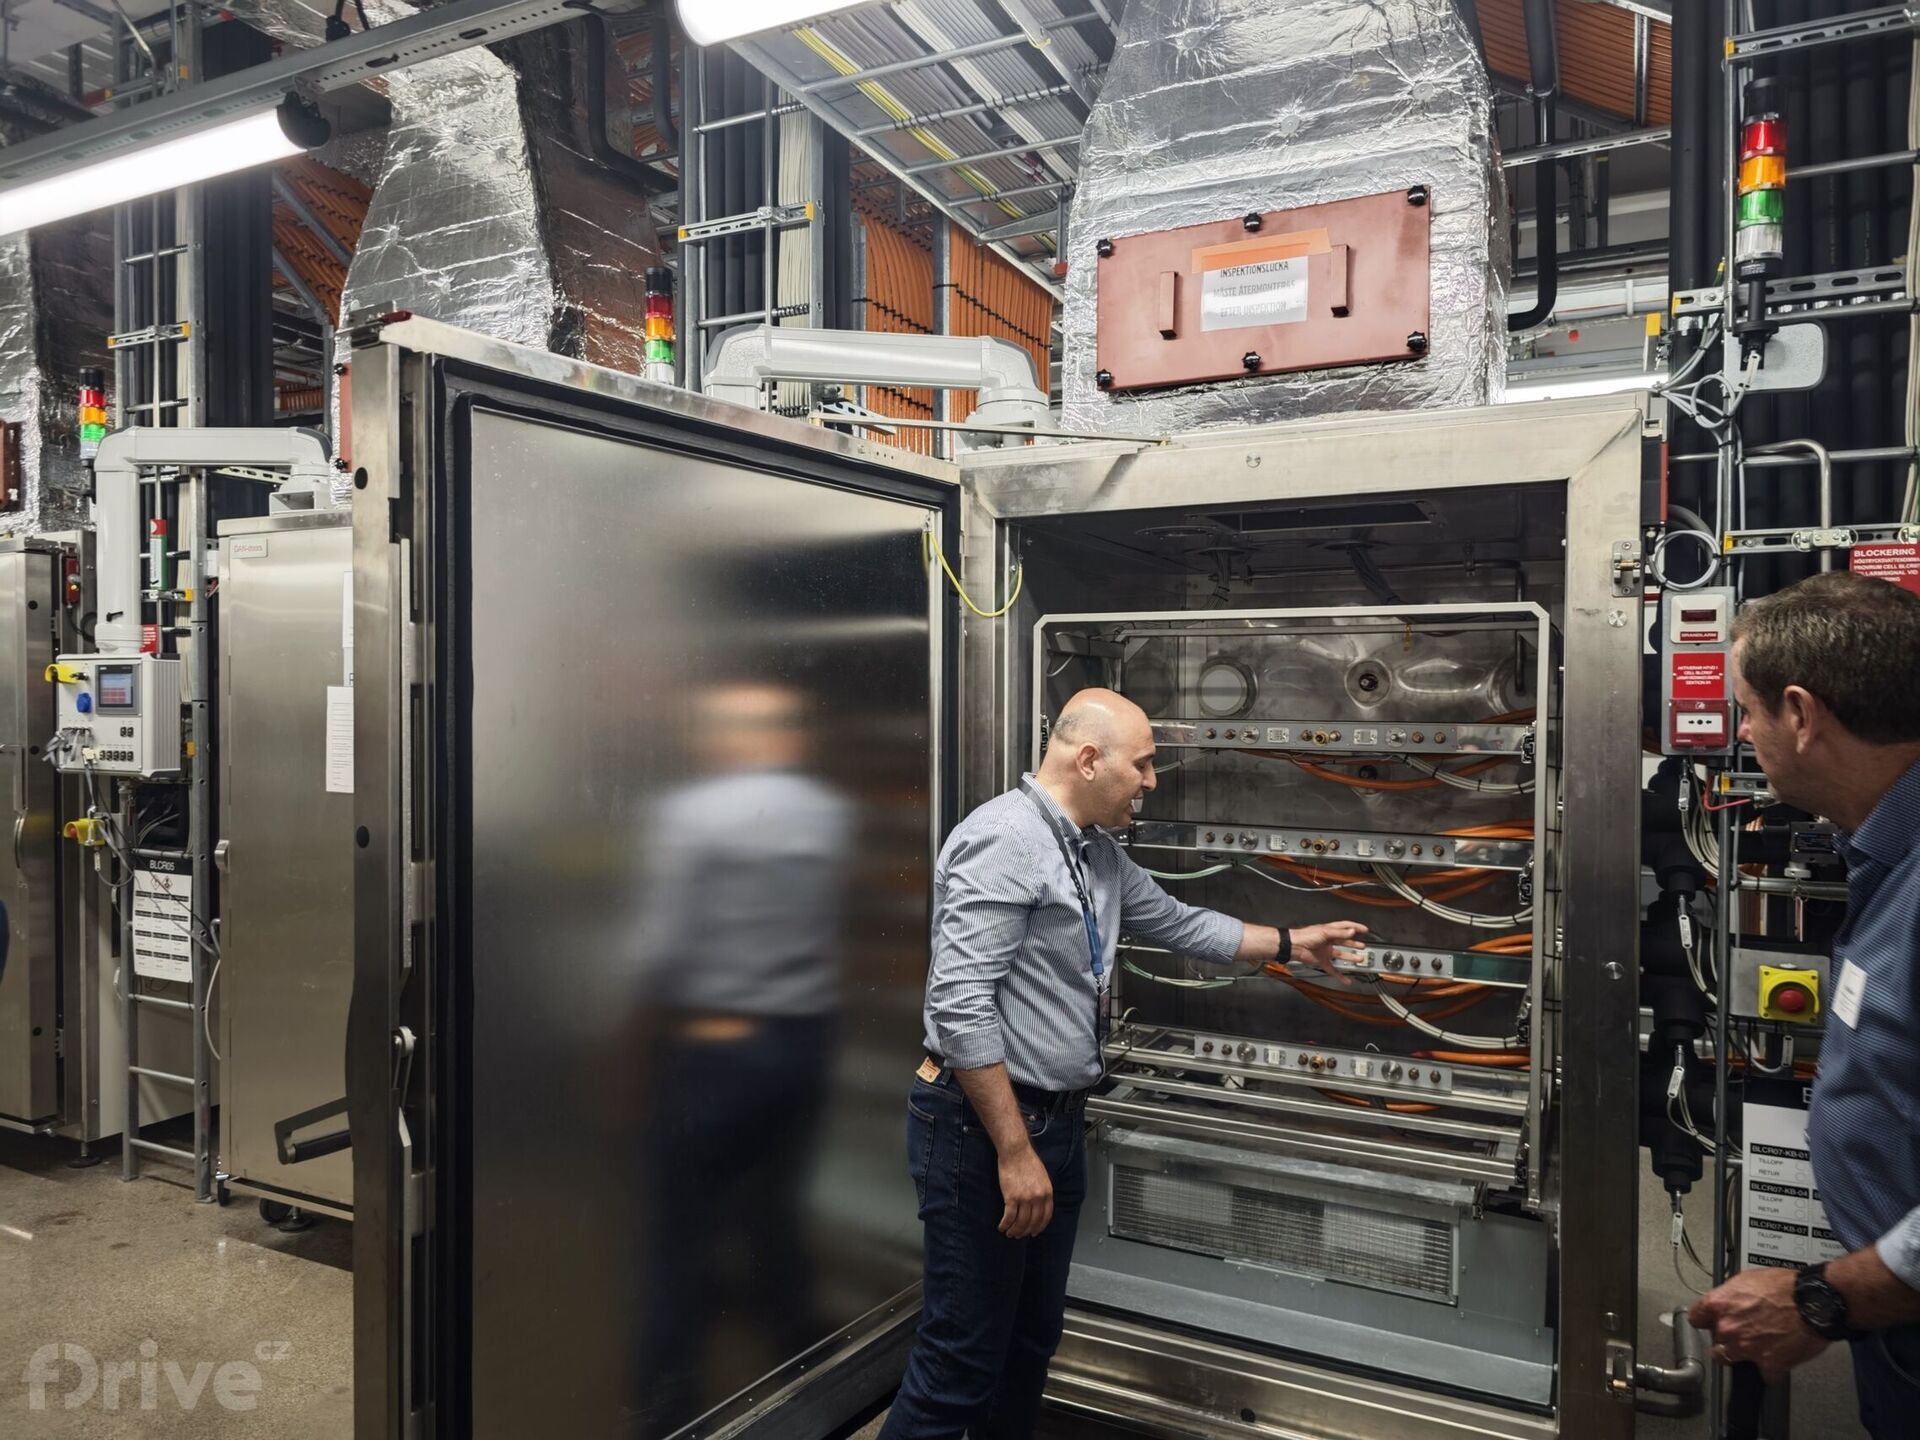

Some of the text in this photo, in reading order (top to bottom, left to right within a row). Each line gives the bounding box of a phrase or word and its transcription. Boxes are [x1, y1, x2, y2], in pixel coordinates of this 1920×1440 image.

[1220, 261, 1289, 278] INSPEKTIONSLUCKA
[1213, 286, 1237, 298] MÅSTE
[1854, 548, 1916, 557] BLOCKERING
[1751, 1145, 1809, 1160] BLCR07-KB-01
[1758, 1157, 1784, 1166] TILLOPP
[1758, 1169, 1780, 1177] RETUR
[1750, 1182, 1808, 1197] BLCR07-KB-04
[1758, 1195, 1783, 1203] TILLOPP
[1757, 1206, 1780, 1214] RETUR
[1750, 1219, 1807, 1234] BLCR07-KB-07
[1757, 1232, 1782, 1240] TILLOPP
[1756, 1242, 1779, 1250] RETUR
